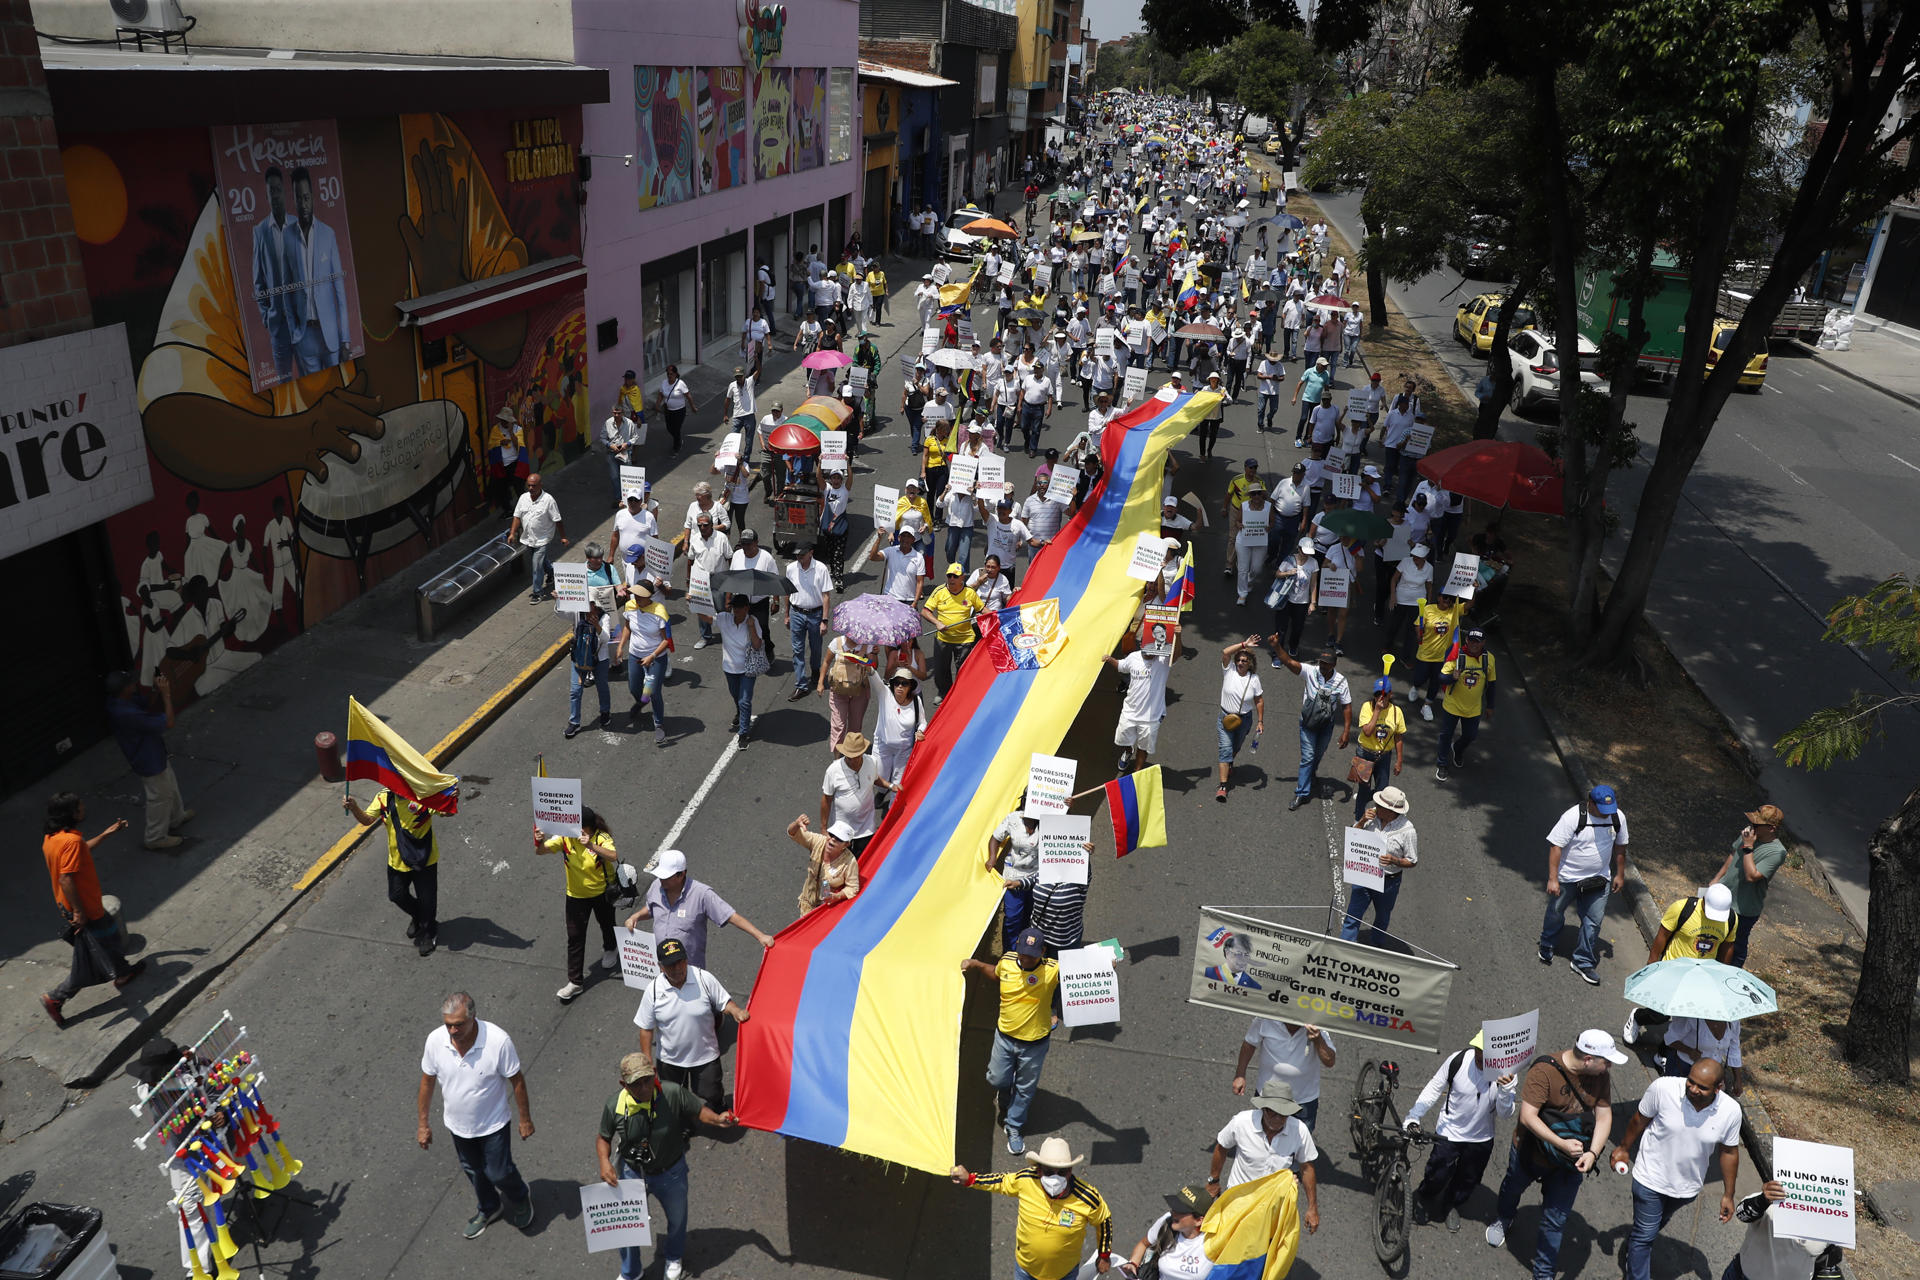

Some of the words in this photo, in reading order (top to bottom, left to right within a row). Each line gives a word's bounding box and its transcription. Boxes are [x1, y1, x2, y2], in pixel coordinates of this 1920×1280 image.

[513, 120, 531, 148] LA
[533, 118, 562, 145] TOPA
[224, 125, 326, 173] Herencia
[284, 159, 294, 168] DE
[318, 176, 341, 201] 50
[229, 187, 256, 215] 20
[1, 400, 74, 434] PUNTO
[647, 549, 669, 560] RENUNCIE
[649, 545, 668, 555] CUANDO
[1030, 767, 1075, 780] CONGRESISTAS
[1043, 776, 1070, 786] TOQUEN:
[1045, 785, 1066, 793] SALUD
[539, 797, 574, 805] CÓMPLICE
[1040, 800, 1065, 810] EMPLEO
[535, 809, 581, 824] NARCOTERRORISMO
[1350, 842, 1381, 852] GOBIERNO
[1246, 925, 1271, 938] TOTAL
[1273, 931, 1311, 948] RECHAZO
[624, 939, 649, 951] CUANDO
[1272, 943, 1282, 952] AL
[623, 947, 653, 959] RENUNCIE
[1256, 950, 1289, 966] PINOCHO
[623, 954, 639, 963] ALEX
[640, 957, 656, 967] VEGA
[627, 962, 648, 972] VAMOS
[1063, 973, 1074, 982] ¡NI
[1094, 970, 1114, 979] MÁS!
[1249, 967, 1292, 983] GUERRILLERO
[1306, 954, 1401, 985] MITOMANO
[1066, 980, 1102, 990] POLICÍAS
[1302, 966, 1401, 997] MENTIROSO
[1069, 989, 1111, 998] SOLDADOS
[1208, 982, 1218, 991] el
[1223, 984, 1248, 998] KK's
[1066, 997, 1115, 1007] ASESINADOS
[1290, 980, 1326, 998] Gran
[1330, 990, 1405, 1017] desgracia
[1268, 990, 1289, 1004] de
[1296, 996, 1416, 1033] COLOMBIA
[1491, 1028, 1531, 1042] GOBIERNO
[1491, 1035, 1530, 1049] CÓMPLICE
[1484, 1046, 1535, 1069] NARCOTERRORISMO
[1777, 1169, 1791, 1179] ¡NI
[1794, 1171, 1817, 1182] UNO
[1821, 1175, 1849, 1187] MÁS!
[1781, 1180, 1830, 1195] POLICÍAS
[1834, 1188, 1846, 1197] NI
[586, 1203, 599, 1213] ¡NI
[621, 1199, 643, 1208] MÁS!
[1785, 1192, 1843, 1207] SOLDADOS
[590, 1208, 630, 1218] POLICÍAS
[1779, 1202, 1849, 1218] ASESINADOS
[594, 1215, 640, 1225] SOLDADOS
[590, 1222, 645, 1234] ASESINADOS
[1181, 1255, 1200, 1265] SOS
[1179, 1265, 1199, 1274] CALI
